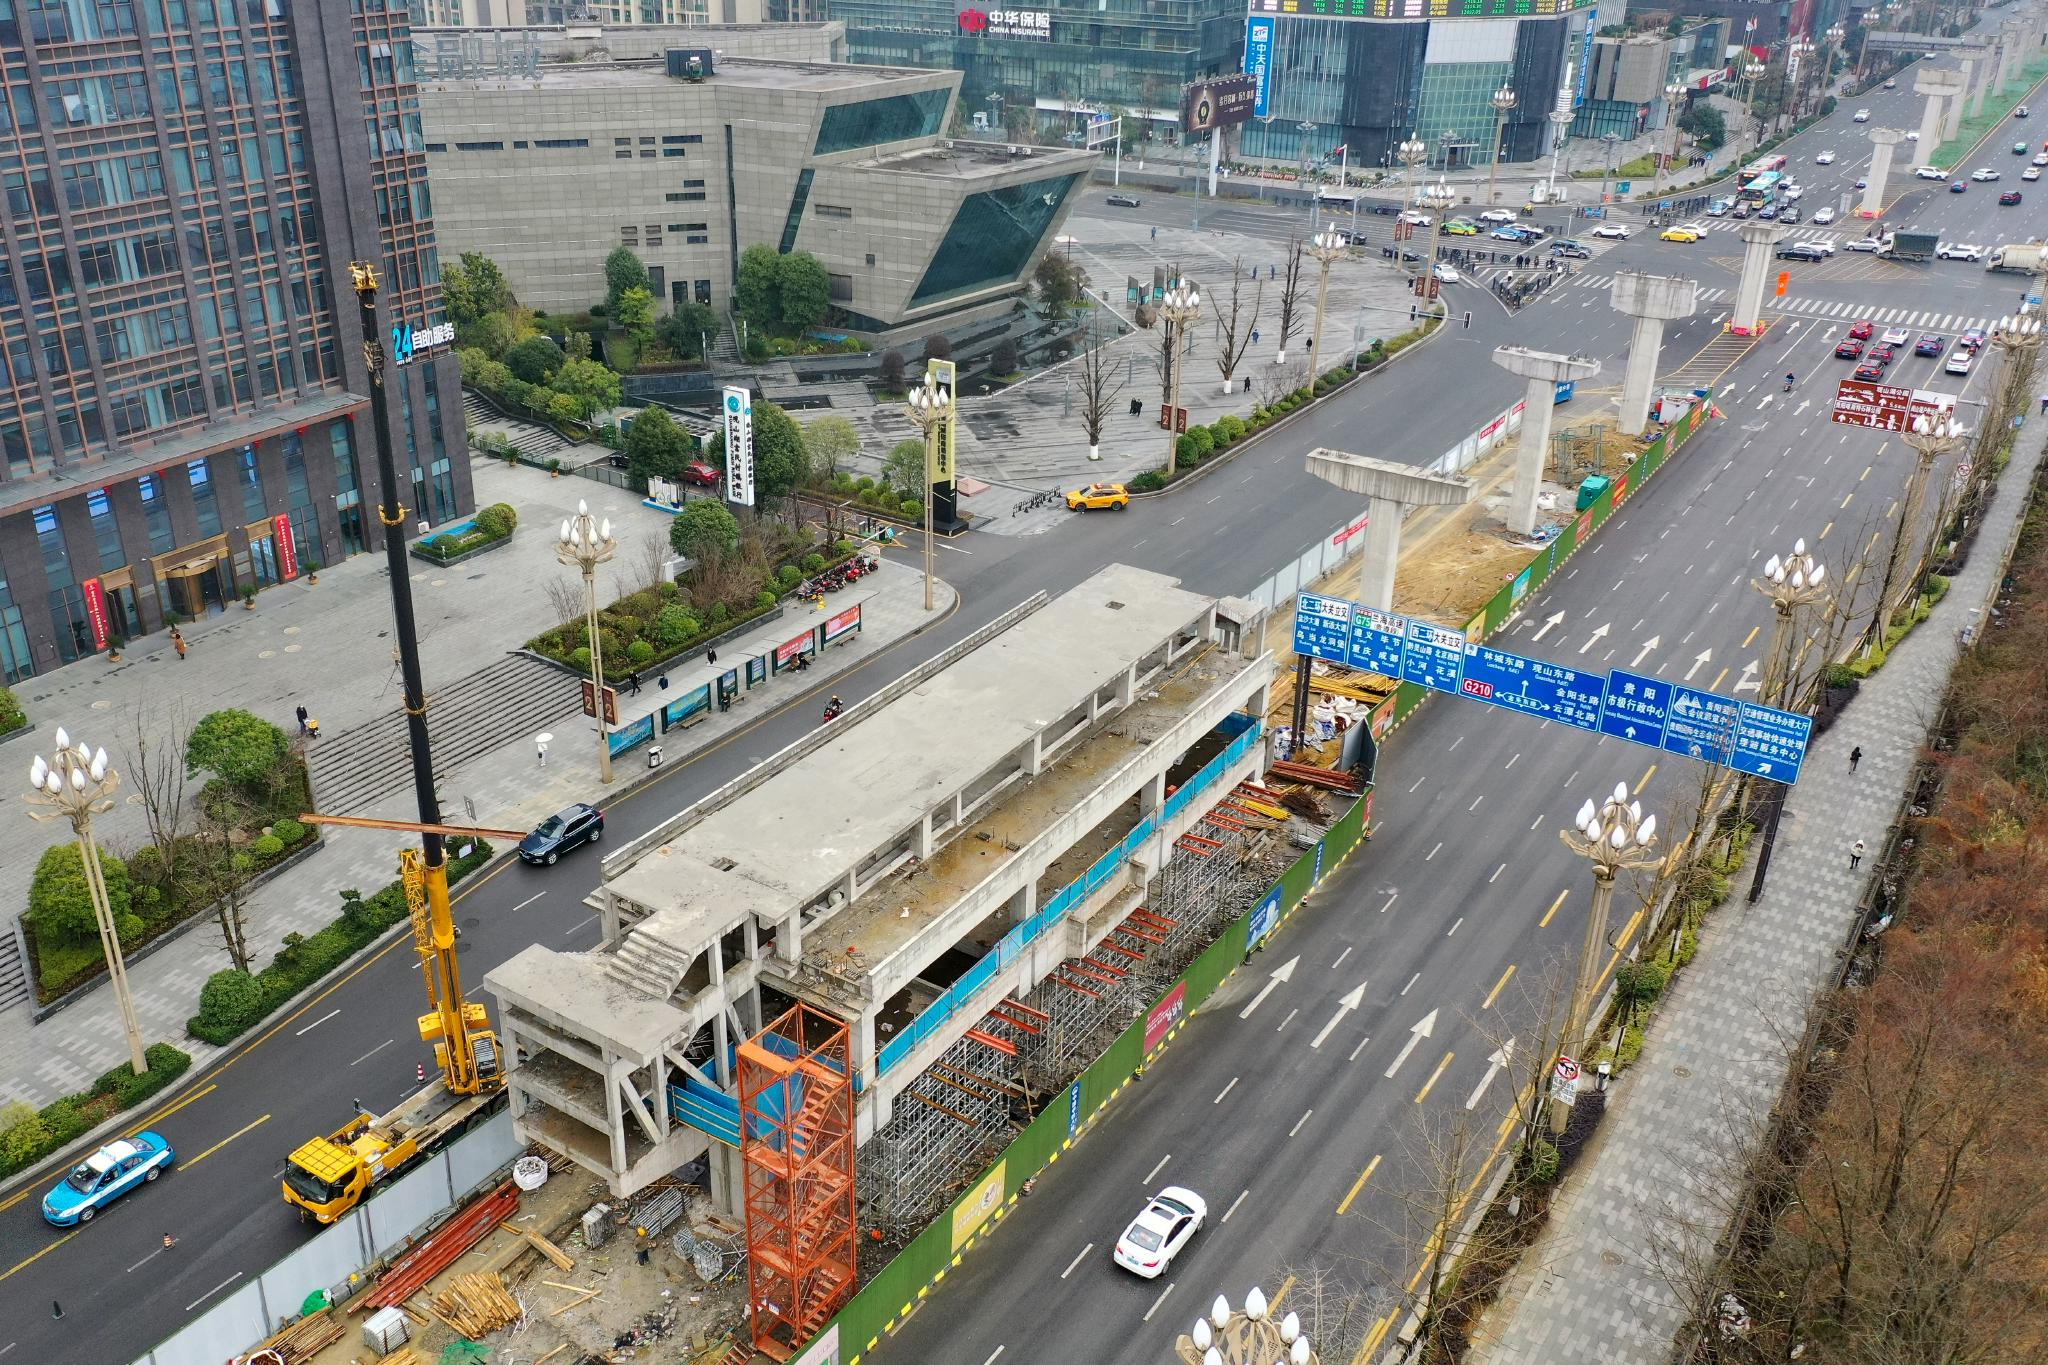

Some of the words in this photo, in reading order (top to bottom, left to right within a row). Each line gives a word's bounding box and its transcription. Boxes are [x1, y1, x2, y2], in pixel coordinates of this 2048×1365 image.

[990, 10, 1050, 27] 中华保险
[989, 26, 1009, 34] CHINA
[1011, 28, 1050, 36] INSURANCE
[393, 325, 412, 360] 24
[412, 322, 454, 350] 自助服务
[1877, 386, 1910, 397] 观山湖公园
[1163, 415, 1168, 425] 2
[1178, 419, 1184, 428] 2
[1322, 604, 1347, 618] 大关立交
[1355, 615, 1371, 627] G75
[1373, 614, 1404, 629] 兰海高速
[1296, 631, 1317, 641] 乌当
[1320, 636, 1344, 648] 龙洞堡
[1354, 628, 1373, 640] 遵义
[1381, 635, 1401, 647] 毕节
[1412, 626, 1433, 641] 西二环
[1434, 633, 1460, 648] 大关立交
[1352, 644, 1372, 656] 重庆
[1379, 651, 1398, 662] 成都
[1407, 642, 1432, 655] 黔灵山路
[1435, 649, 1459, 662] 北京西路
[1406, 659, 1427, 670] 小河
[1435, 666, 1456, 678] 花溪
[1484, 652, 1525, 669] 林城东路
[1532, 663, 1575, 682] 观山东路
[1464, 680, 1491, 696] G210
[1556, 688, 1599, 706] 金阳北路
[1624, 682, 1656, 700] 贵阳
[585, 696, 592, 710] 2
[605, 704, 613, 718] 2
[1607, 694, 1665, 719] 市级行政中心
[1553, 704, 1596, 722] 云潭北路
[1744, 708, 1808, 730] 交通管理业务办理大厅
[1740, 726, 1804, 750] 交通事故快速处理
[1740, 738, 1798, 760] 理赔服务中心
